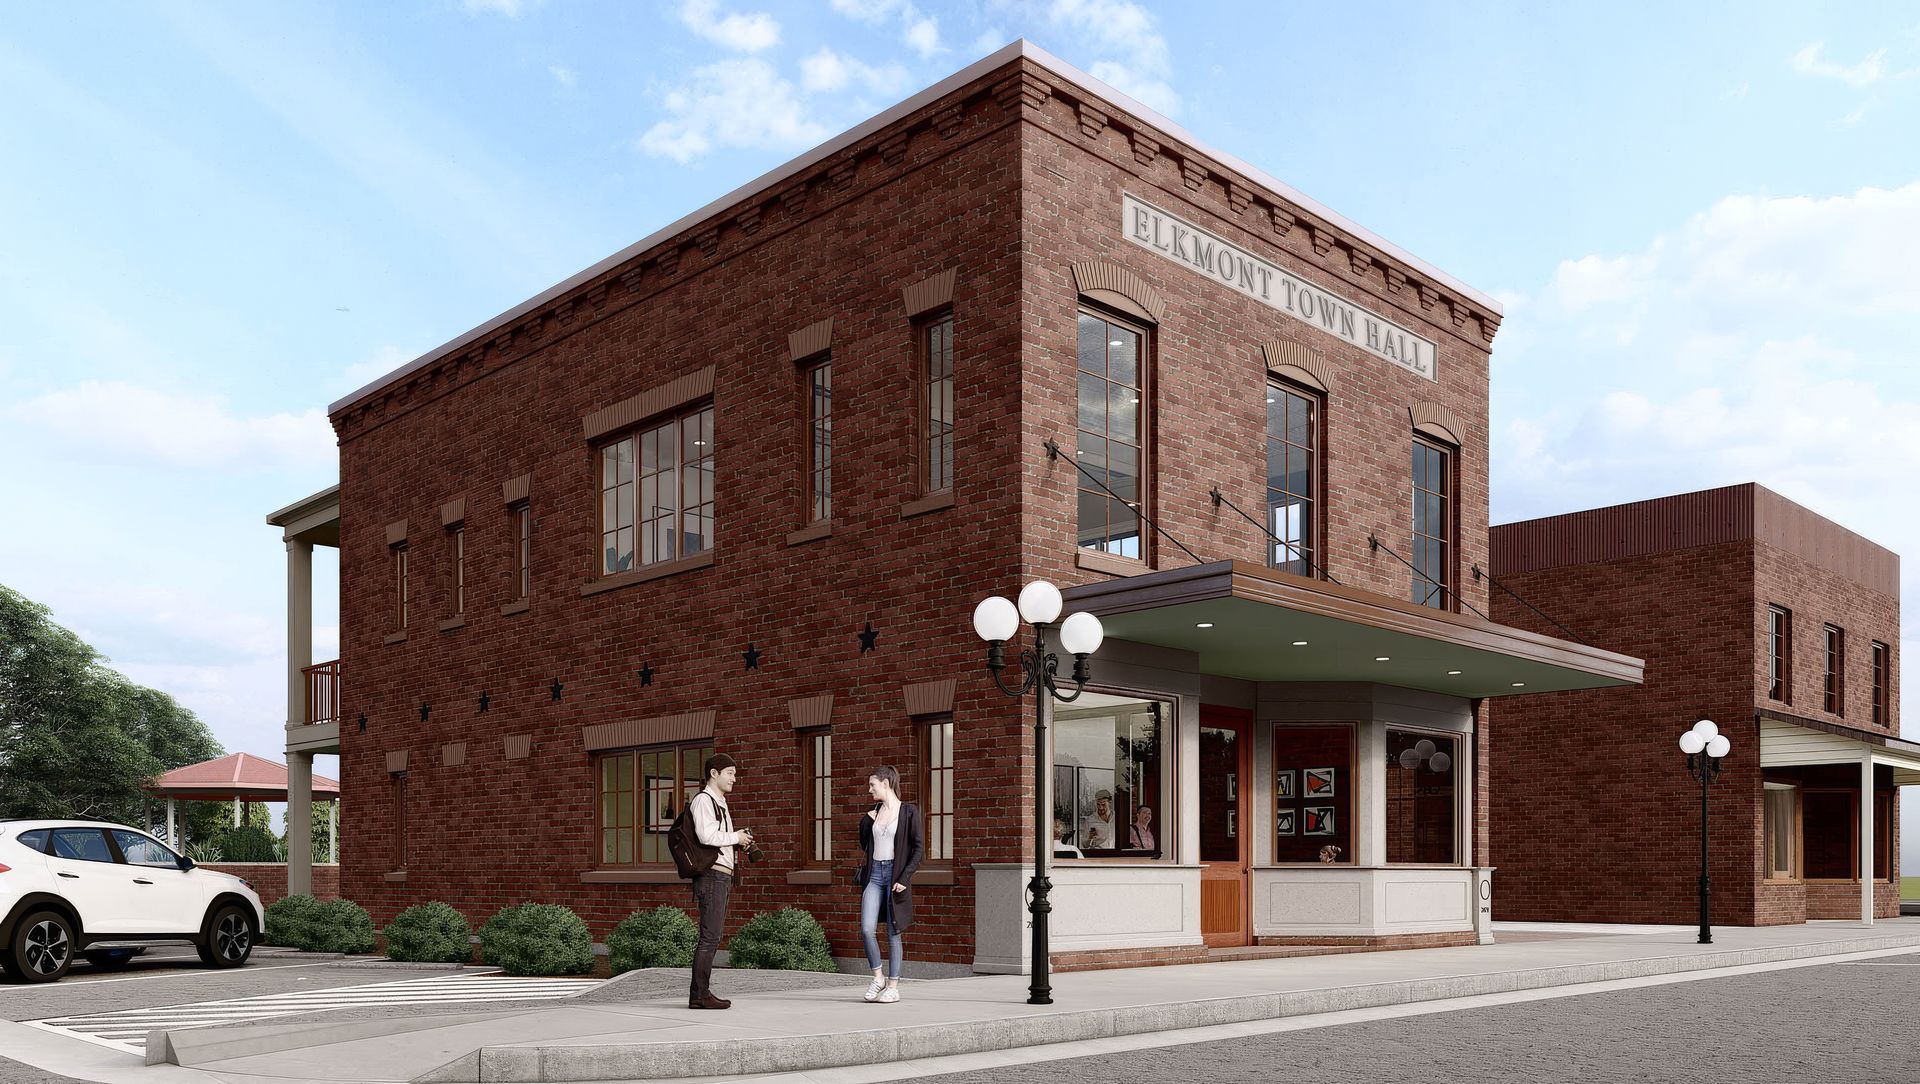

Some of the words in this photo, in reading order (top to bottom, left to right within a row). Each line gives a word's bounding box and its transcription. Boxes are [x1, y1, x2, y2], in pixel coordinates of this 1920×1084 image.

[1133, 206, 1272, 300] ELKMONT
[1282, 278, 1355, 340] TOWN
[1365, 318, 1426, 373] HALL
